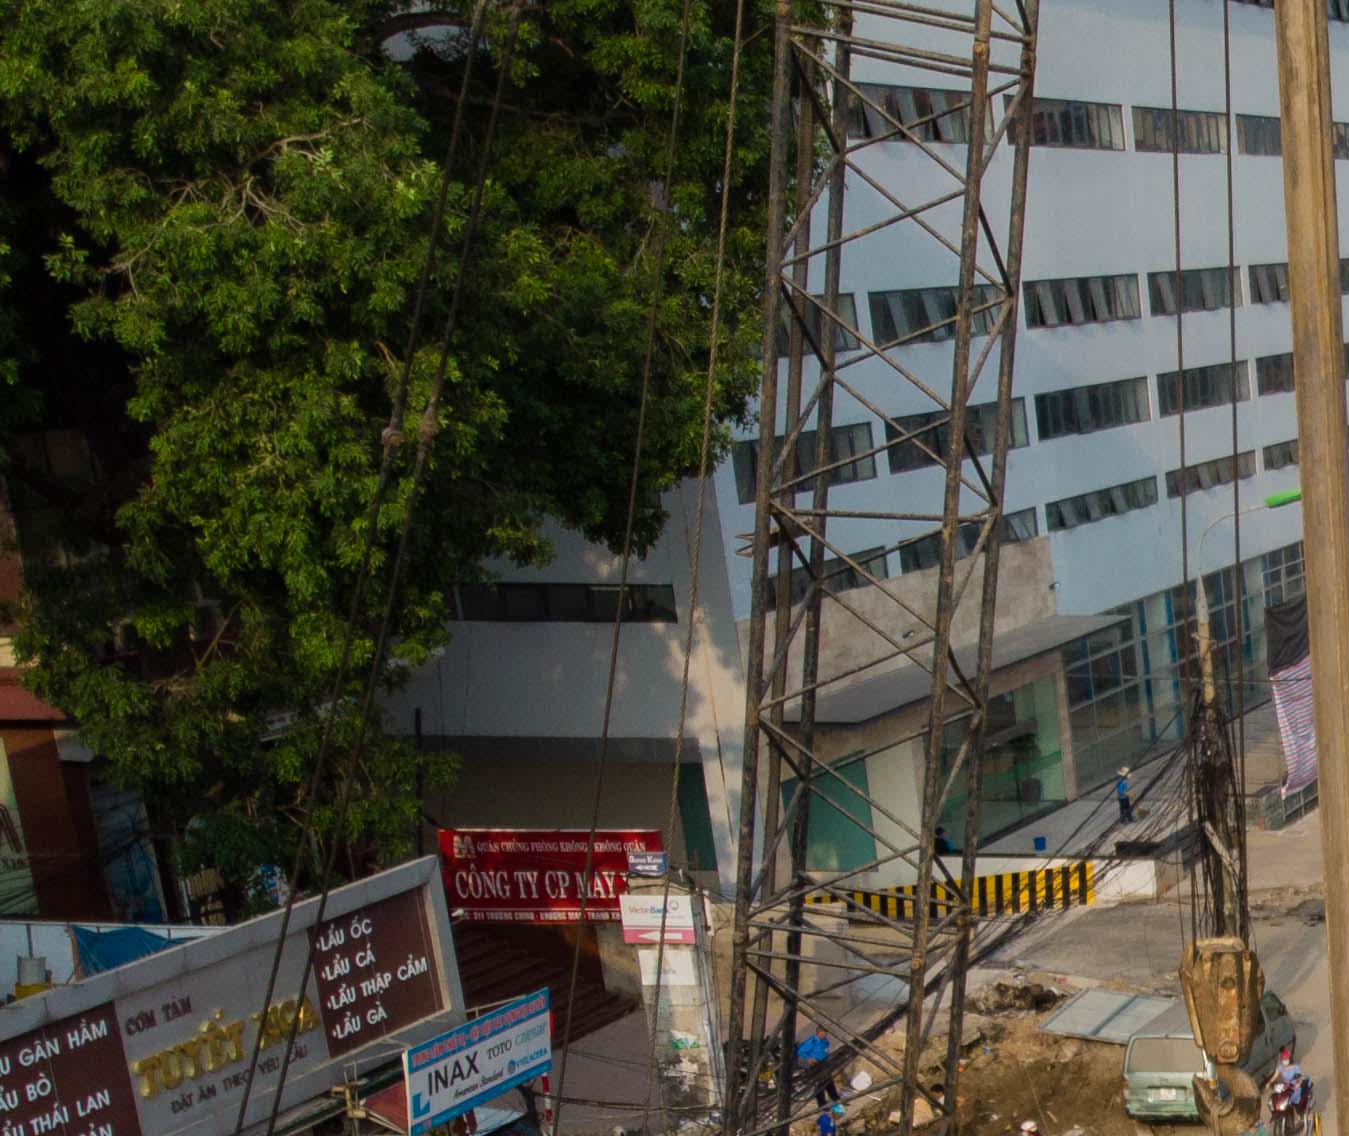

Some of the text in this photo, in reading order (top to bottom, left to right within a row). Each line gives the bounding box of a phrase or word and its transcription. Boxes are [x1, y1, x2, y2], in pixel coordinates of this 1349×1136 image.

[455, 863, 619, 900] CÔNG TY CP MAY
[320, 914, 373, 952] LẨU ỐC
[325, 943, 376, 981] LẨU CÁ
[330, 953, 429, 1010] LẨU THẬP CẨM
[67, 1017, 109, 1050] HẦM
[336, 1000, 388, 1039] LẨU GÀ
[131, 1008, 246, 1100] TUYẾT
[427, 1050, 480, 1096] INAX
[486, 1039, 512, 1060] TOTO
[26, 1072, 52, 1101] BÒ
[76, 1088, 110, 1119] LAN
